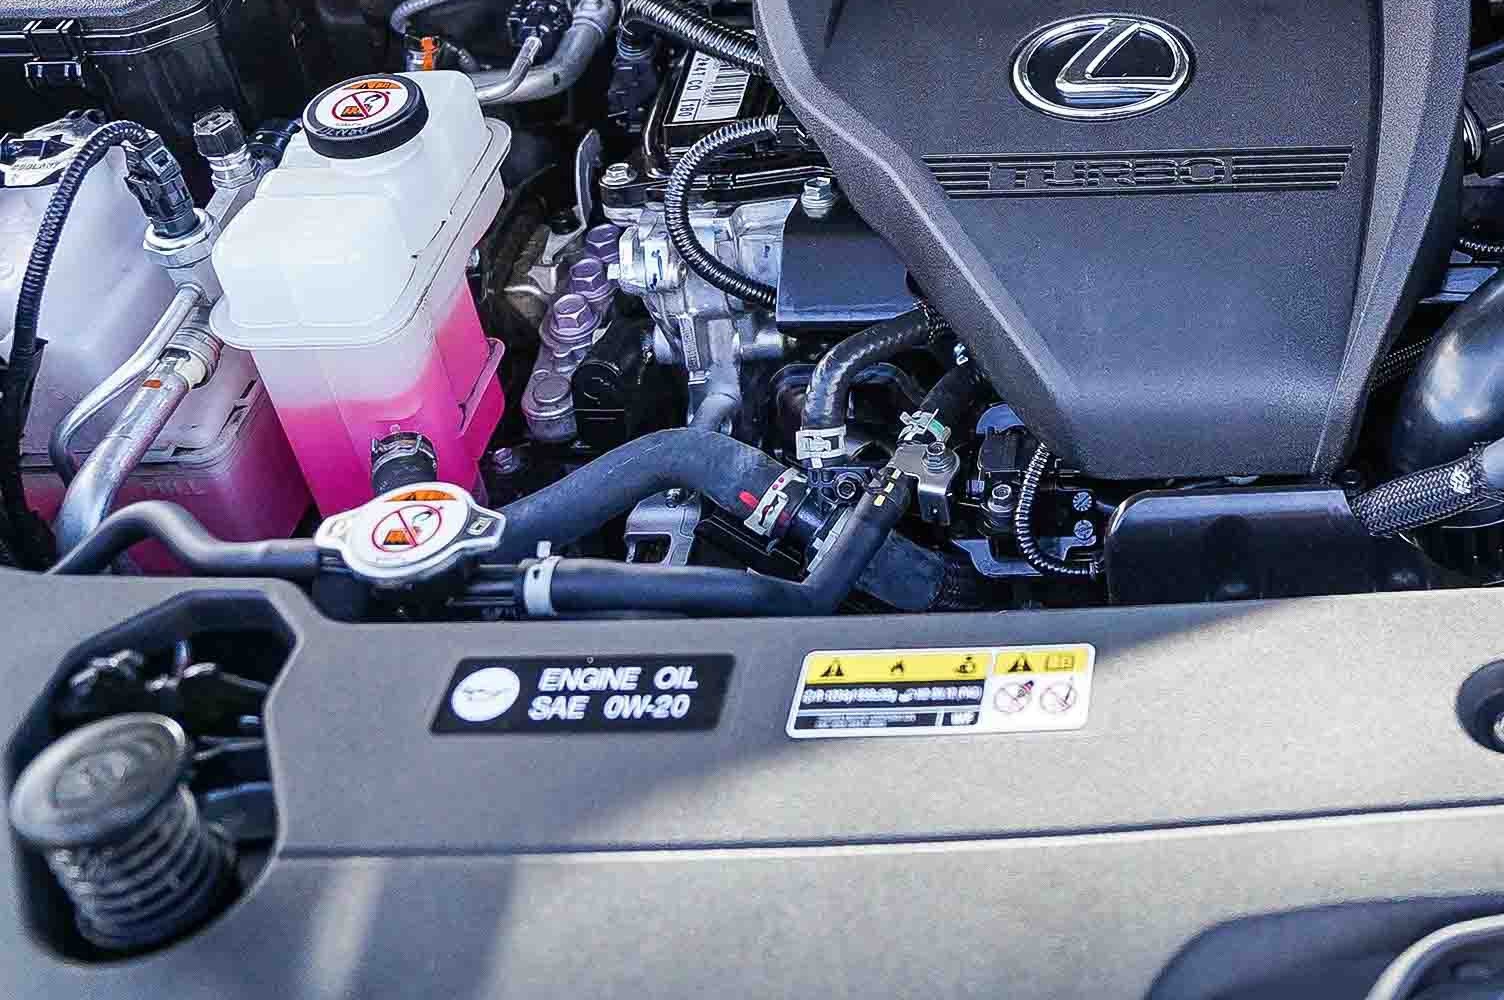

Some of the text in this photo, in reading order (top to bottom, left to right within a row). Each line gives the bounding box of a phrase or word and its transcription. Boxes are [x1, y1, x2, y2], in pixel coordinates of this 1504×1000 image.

[998, 157, 1226, 190] TURBO
[537, 665, 699, 691] ENGINE OIL
[527, 695, 590, 721] SAE
